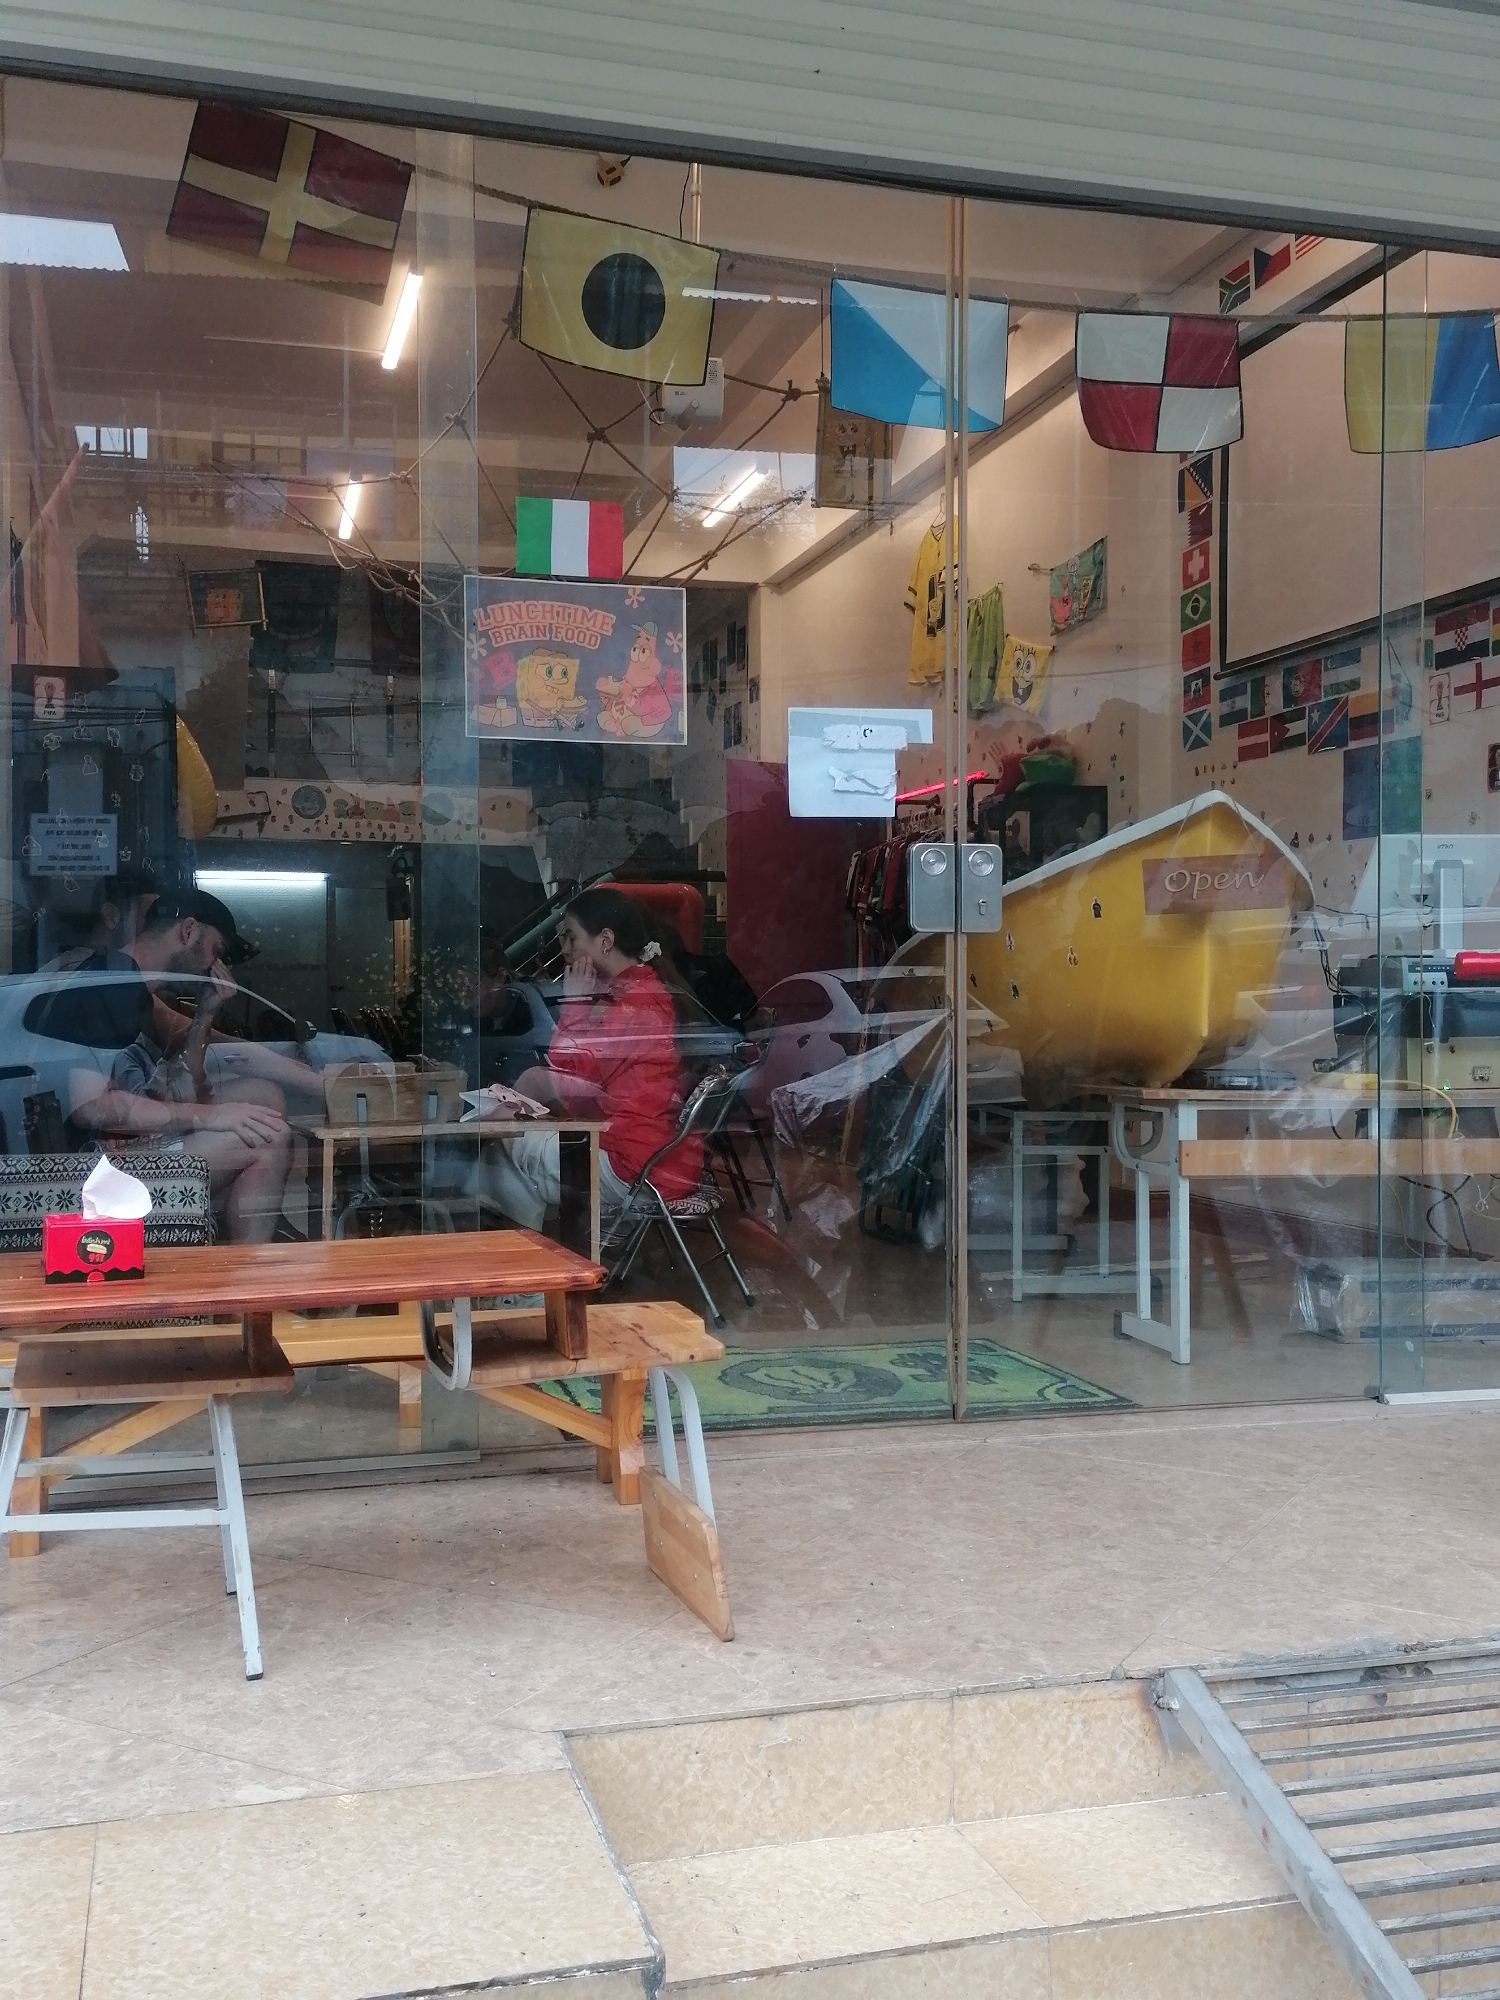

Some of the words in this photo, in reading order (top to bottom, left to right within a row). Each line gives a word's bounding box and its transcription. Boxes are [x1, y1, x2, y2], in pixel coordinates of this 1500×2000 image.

[477, 602, 616, 634] LUNCHTIME
[490, 624, 549, 646] BRAIN
[553, 624, 600, 649] FOOD
[1164, 869, 1265, 900] Open
